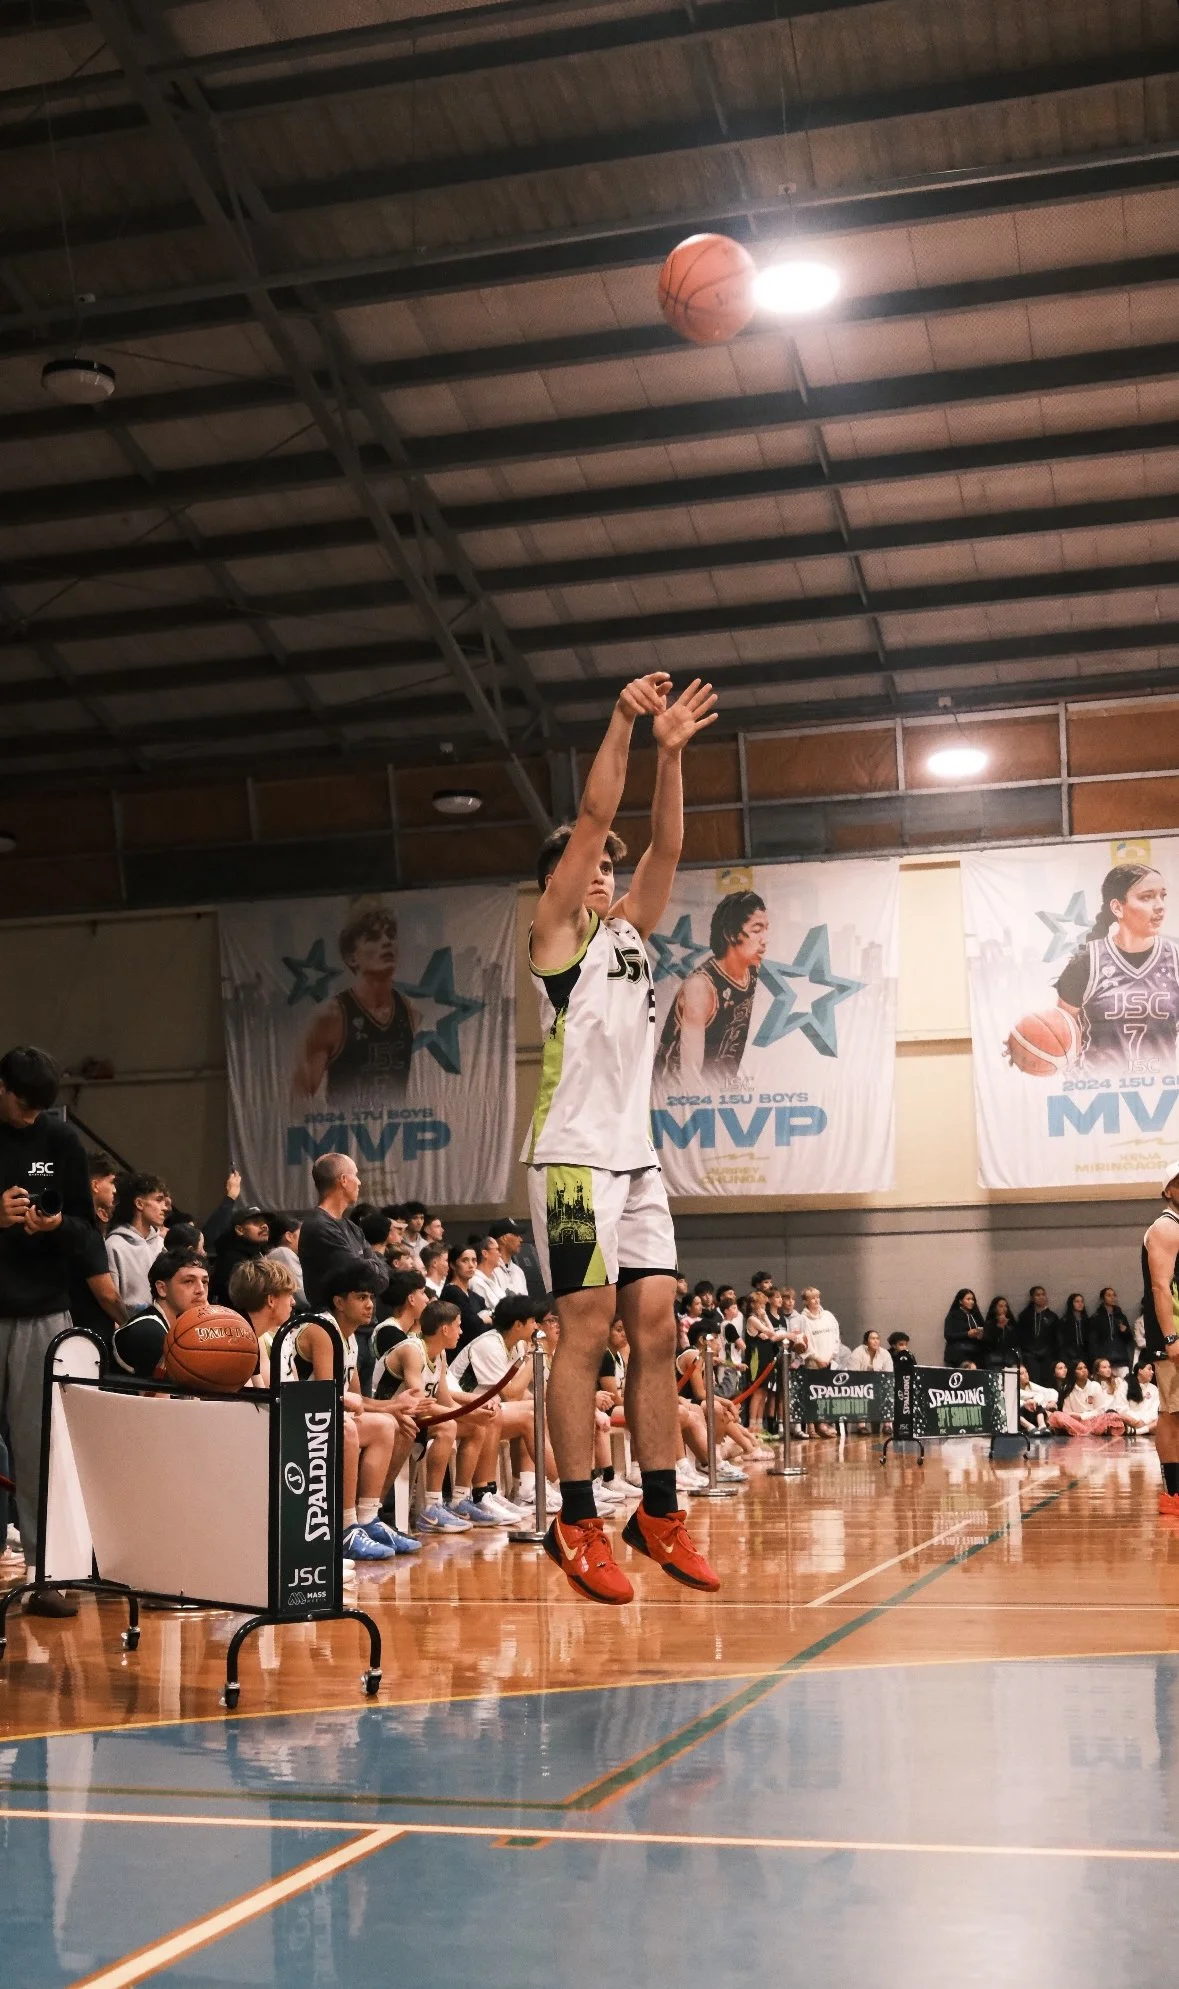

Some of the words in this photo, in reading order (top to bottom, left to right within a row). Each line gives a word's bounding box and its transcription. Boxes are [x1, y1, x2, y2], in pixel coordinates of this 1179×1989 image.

[1105, 991, 1170, 1020] JSC
[1124, 1024, 1147, 1061] 7
[1063, 1079, 1111, 1091] 2024
[1119, 1077, 1155, 1088] 15U
[1162, 1075, 1179, 1086] GI
[666, 1095, 712, 1106] 2024
[718, 1093, 753, 1105] 15U
[759, 1092, 809, 1104] BOYS
[1047, 1089, 1179, 1137] MV
[651, 1106, 828, 1149] MVP
[287, 1120, 452, 1165] MVP
[28, 1161, 54, 1174] JSC
[809, 1384, 874, 1400] SPALDING
[903, 1375, 911, 1415] SPALDING
[928, 1387, 986, 1408] SPALDING
[304, 1411, 332, 1542] SPALDING
[288, 1566, 327, 1587] JSC
[307, 1591, 327, 1599] MASS
